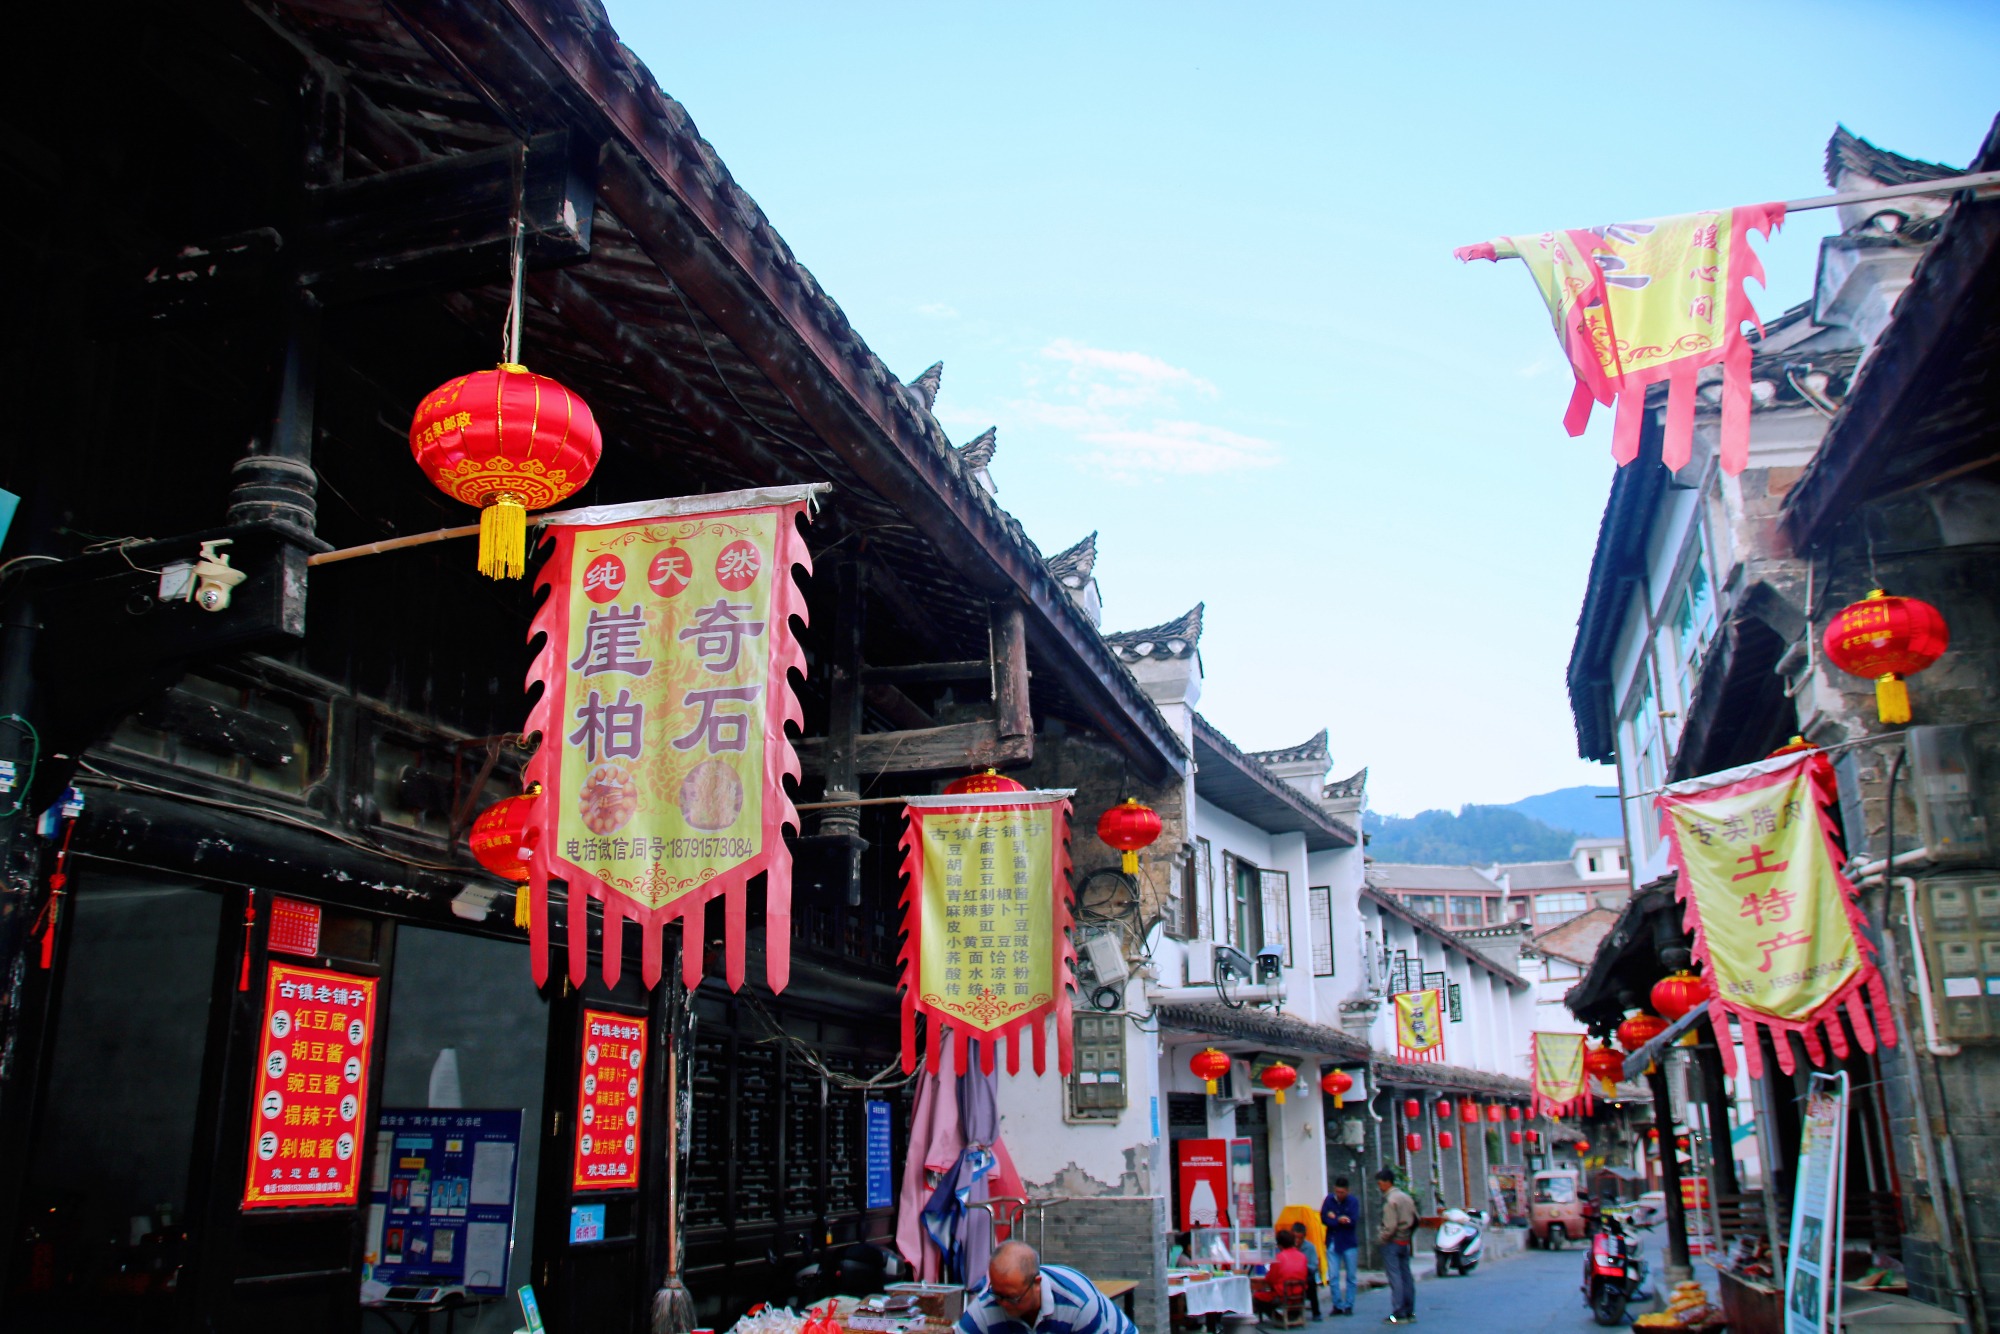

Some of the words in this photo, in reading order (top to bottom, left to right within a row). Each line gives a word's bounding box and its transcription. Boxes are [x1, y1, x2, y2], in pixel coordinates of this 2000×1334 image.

[423, 410, 472, 443] 石泉邮政
[582, 547, 761, 594] 纯天然
[569, 604, 653, 763] 崖柏
[673, 600, 765, 753] 奇石
[1689, 799, 1805, 846] 专卖腊肉
[928, 824, 1048, 842] 古镇老铺子
[947, 841, 1029, 856] 豆腐乳
[946, 856, 1028, 872] 胡豆酱
[946, 871, 1029, 887] 豌豆酱
[946, 887, 1029, 903] 青红剁椒酱
[946, 903, 1029, 918] 麻辣萝卜干
[1731, 844, 1813, 974] 土特产
[947, 919, 1029, 933] 皮豇豆
[946, 934, 1029, 949] 小黄豆豆豉
[945, 966, 1029, 981] 酸水凉粉
[279, 980, 365, 1007] 古镇老铺子
[945, 982, 1029, 997] 传统凉面
[294, 1007, 347, 1032] 红豆腐
[591, 1022, 640, 1040] 古镇老铺子
[290, 1039, 344, 1064] 胡豆酱
[600, 1042, 629, 1060] 皮豇豆
[286, 1072, 341, 1095] 豌豆酱
[594, 1114, 624, 1131] 干土豆片
[280, 1137, 335, 1159] 剁椒酱
[587, 1163, 627, 1177] 欢迎品尝
